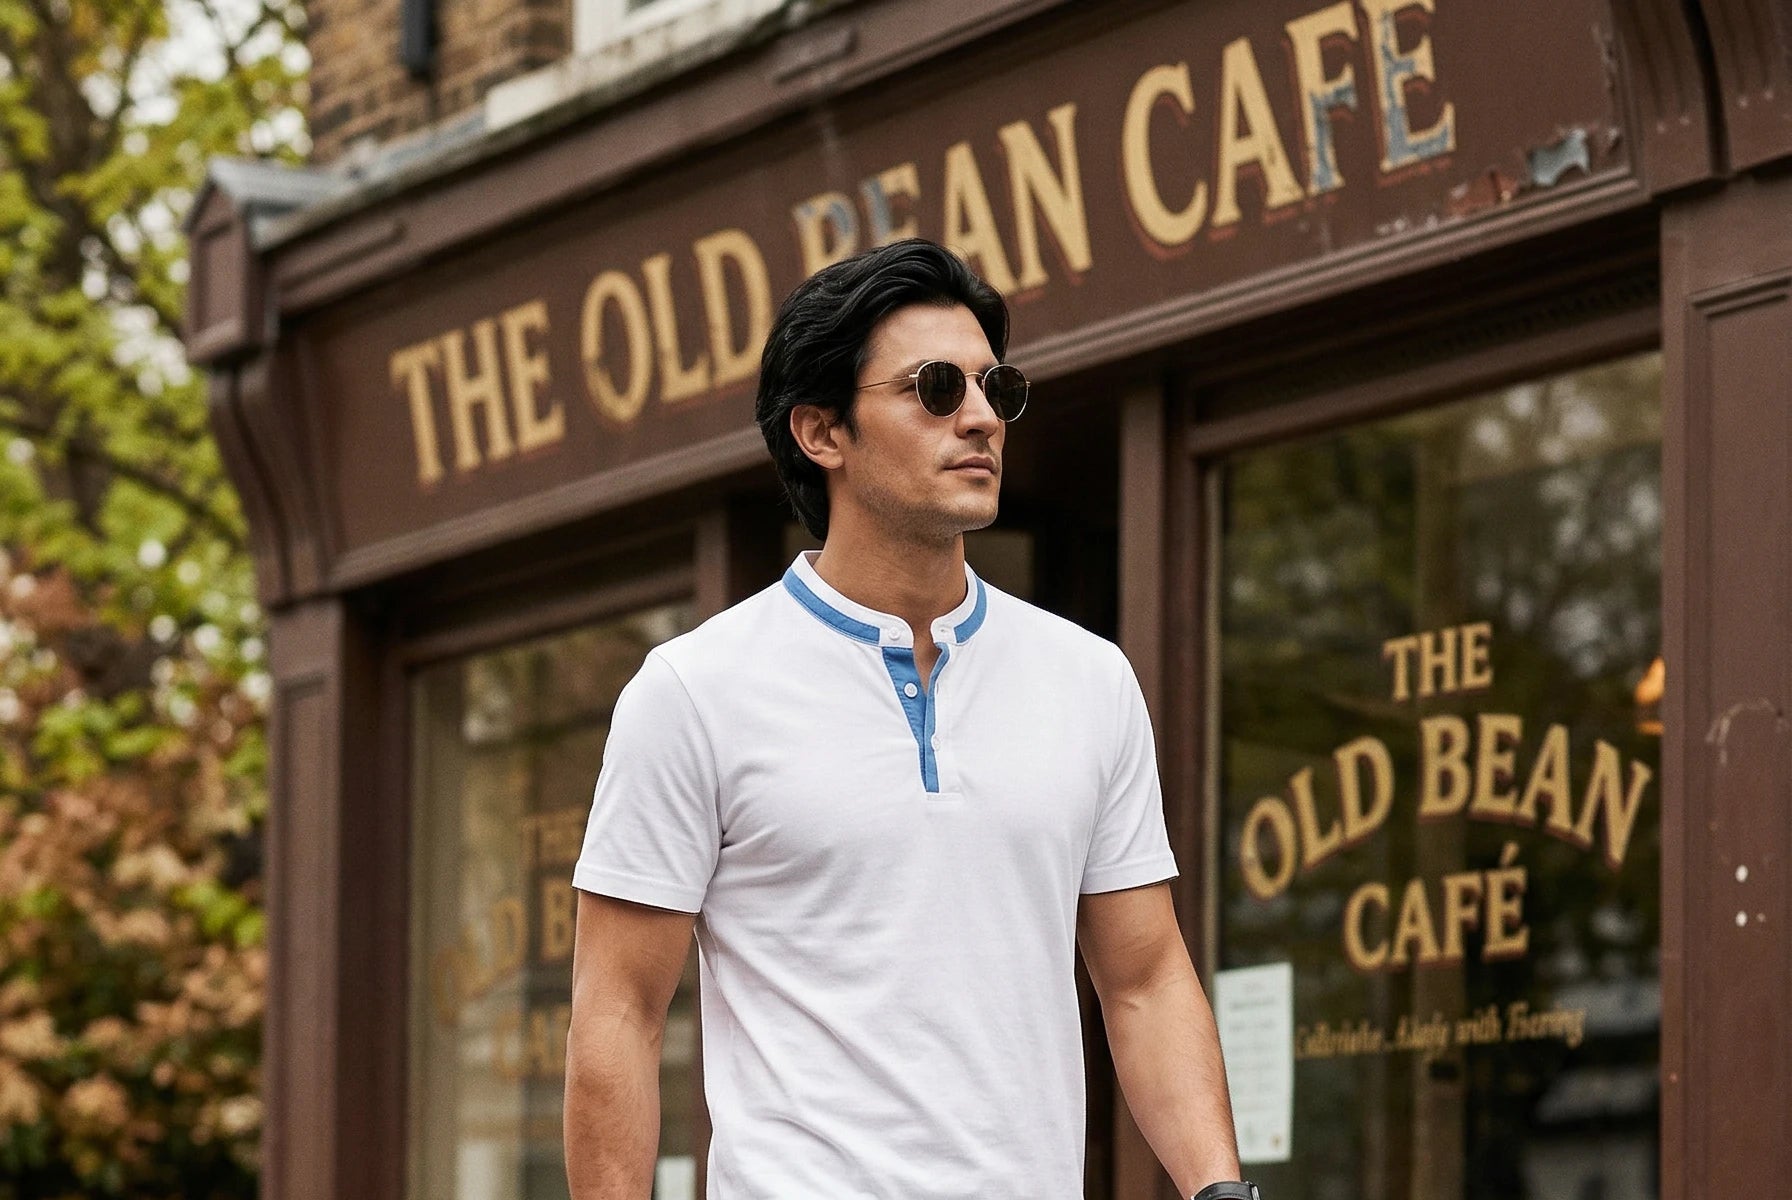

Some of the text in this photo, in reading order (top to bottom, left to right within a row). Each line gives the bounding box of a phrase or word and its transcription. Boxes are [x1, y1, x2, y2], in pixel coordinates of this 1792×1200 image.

[390, 300, 566, 485] THE
[580, 228, 772, 423] OLD
[1121, 0, 1457, 247] CAFE
[1383, 621, 1494, 701] THE
[1239, 712, 1653, 899] OLD BEAN
[1344, 841, 1531, 971] CAFÉ
